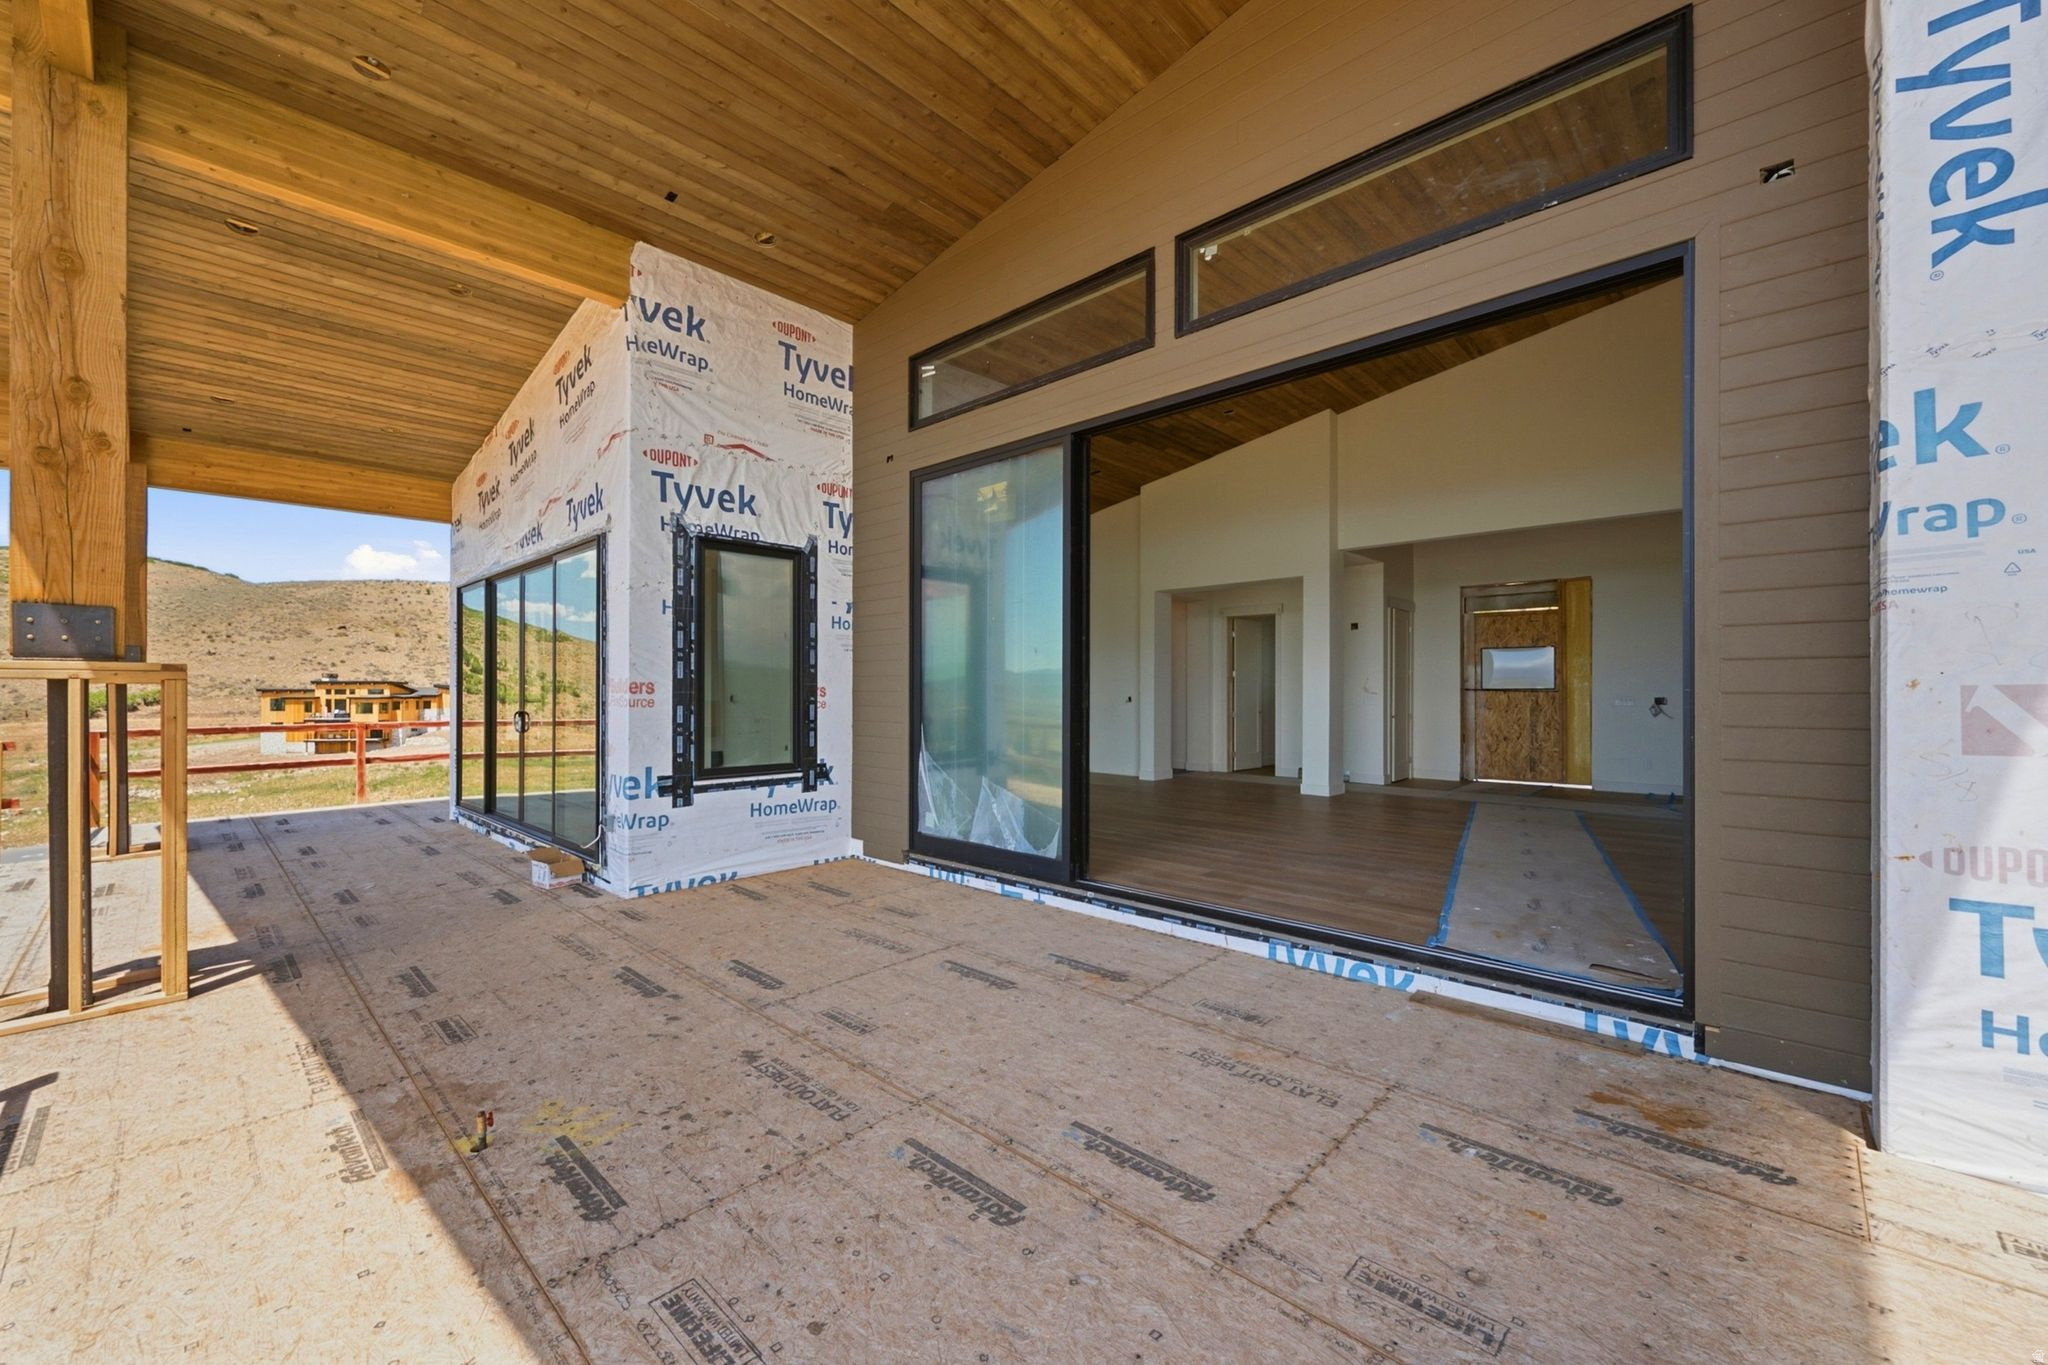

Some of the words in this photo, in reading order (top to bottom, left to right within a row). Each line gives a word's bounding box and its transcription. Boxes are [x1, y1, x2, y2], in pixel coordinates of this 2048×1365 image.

[1895, 0, 2048, 268] Tyvek
[777, 321, 812, 342] DUPONT
[555, 344, 593, 406] Tyvek
[508, 417, 535, 467] Tyvek
[650, 448, 692, 468] DUPONT
[566, 482, 604, 532] Tyvek
[651, 470, 757, 516] Tyvek
[750, 798, 838, 818] HomeWrap
[750, 1061, 789, 1084] BEST
[1183, 1050, 1237, 1073] BEST
[1230, 1070, 1283, 1089] OUT
[782, 1079, 817, 1101] OUT
[808, 1095, 851, 1122] FLAT
[1283, 1084, 1339, 1109] FLAT
[1083, 1139, 1217, 1204] AdvanTech
[1605, 1124, 1798, 1187] AdvanTech
[906, 1157, 1026, 1227] AdvanTech
[1359, 1263, 1439, 1305] WARRANTY
[683, 1286, 723, 1331] WARRANTY
[1355, 1271, 1496, 1347] LIFETIME
[716, 1324, 751, 1358] LIMITED
